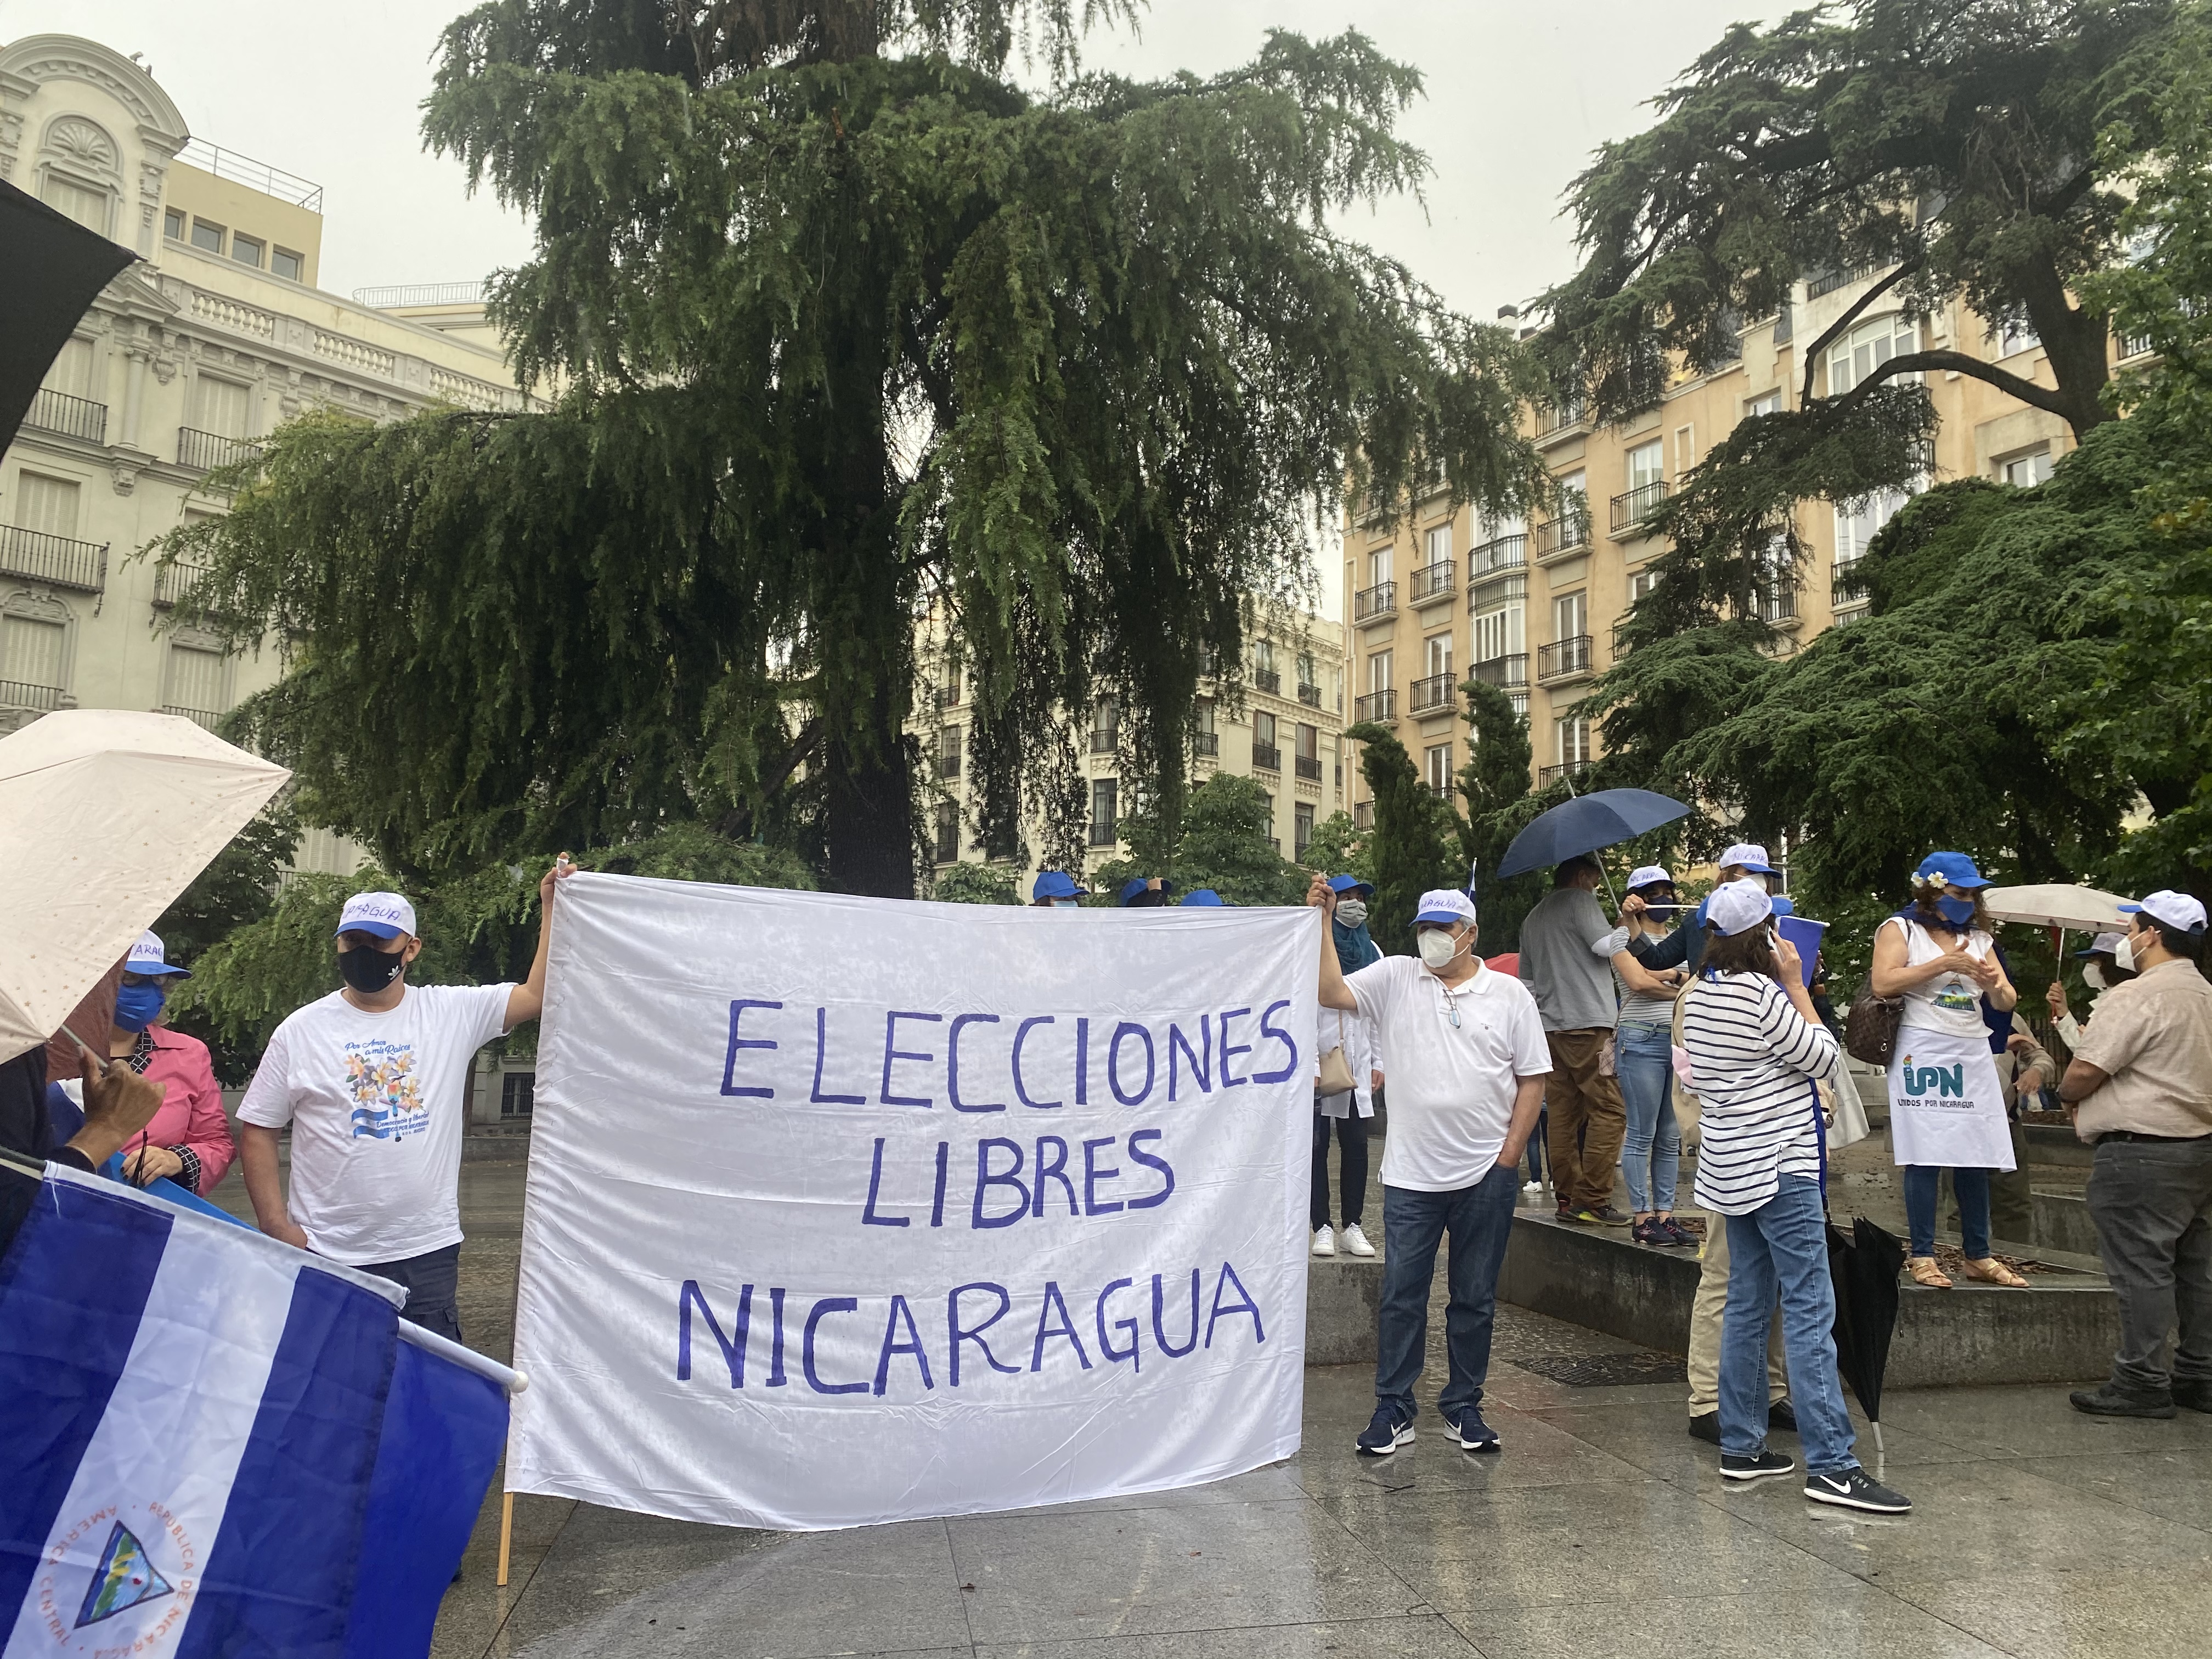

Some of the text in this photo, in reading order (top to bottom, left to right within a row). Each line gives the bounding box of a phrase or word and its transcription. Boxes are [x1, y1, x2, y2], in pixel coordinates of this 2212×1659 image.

[132, 943, 163, 961] ARAG
[345, 1039, 386, 1051] Por Amor
[372, 1046, 384, 1054] mis
[720, 1000, 1298, 1113] ELECCIONES
[1925, 1099, 1938, 1108] POR
[1939, 1100, 1975, 1109] NICARAGUA
[862, 1128, 1176, 1229] LIBRES
[676, 1261, 1266, 1398] NICARAGUA
[40, 1504, 117, 1646] AMERICA CENTRAL
[149, 1501, 194, 1571] REPUBLICA
[176, 1579, 193, 1601] DE
